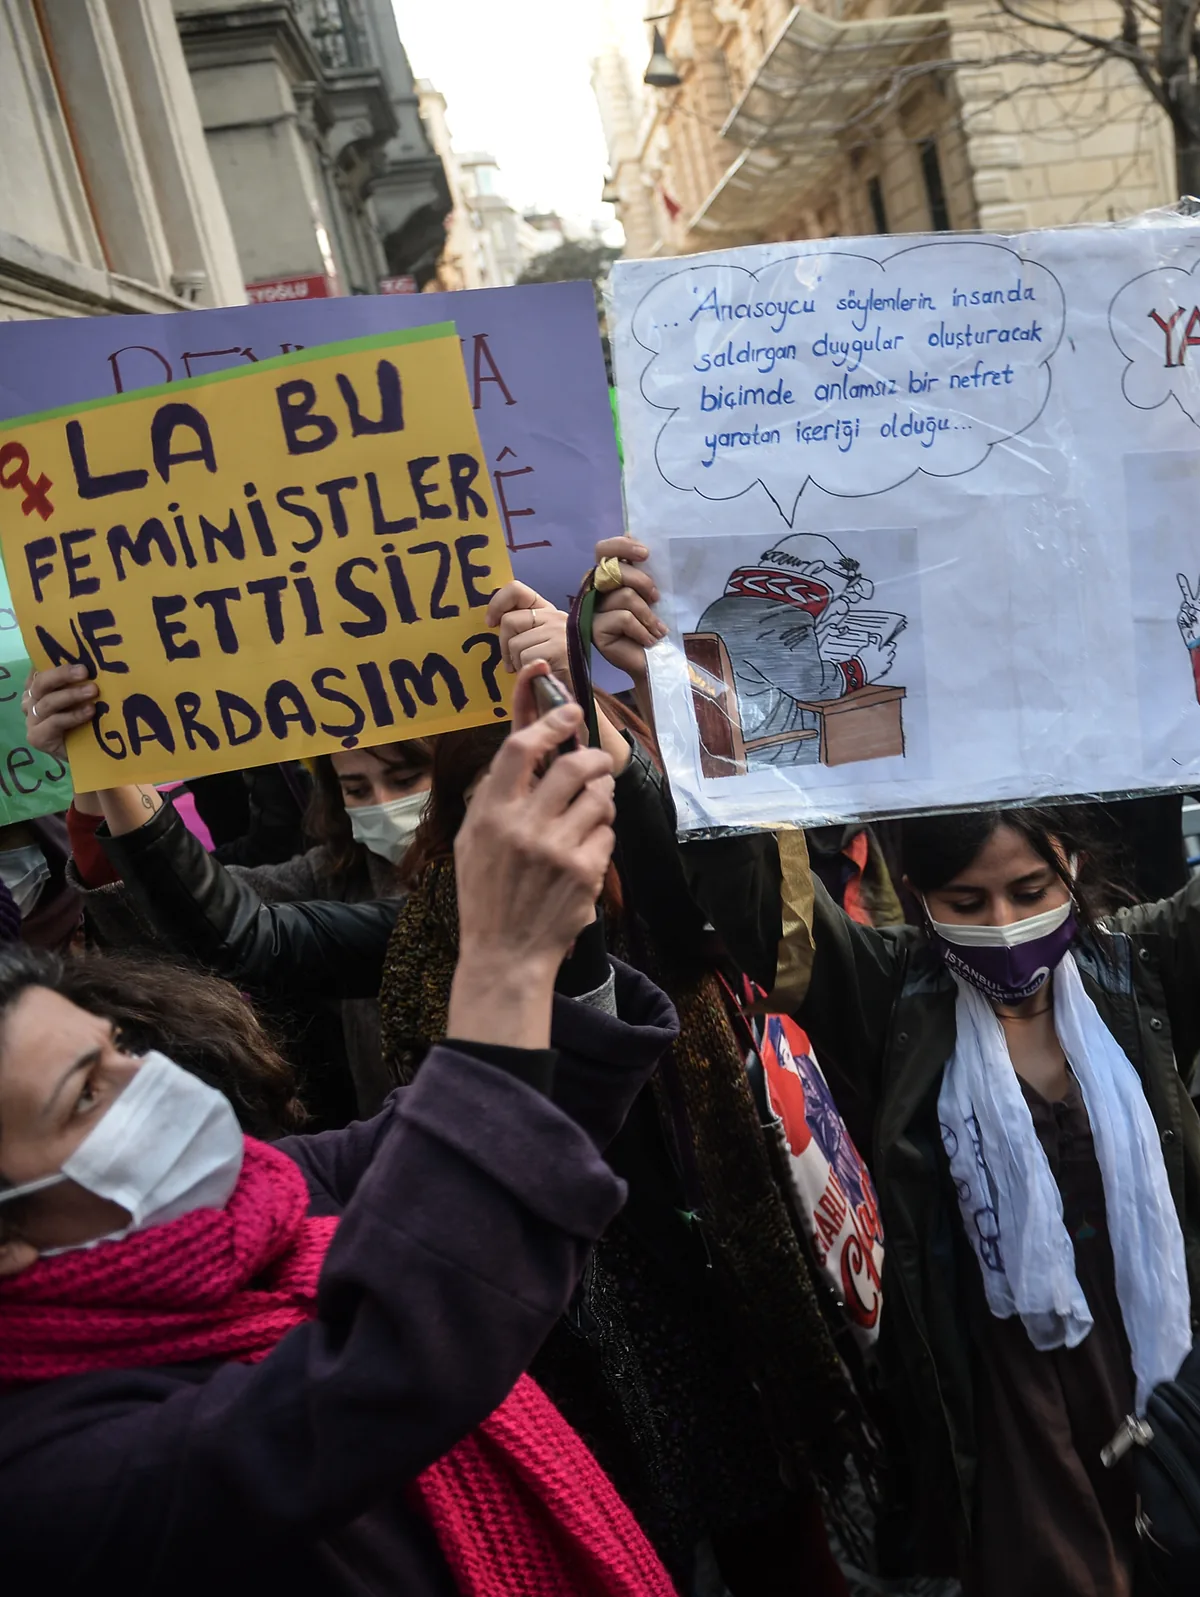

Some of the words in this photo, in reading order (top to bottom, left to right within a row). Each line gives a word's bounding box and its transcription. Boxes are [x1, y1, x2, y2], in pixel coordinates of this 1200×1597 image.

[836, 288, 936, 332] söylemlerin
[952, 279, 1036, 307] insanda
[694, 341, 797, 373] saldırgan
[812, 326, 904, 372] duygular
[927, 319, 1043, 349] oluşturacak
[700, 378, 795, 412] biçimde
[814, 373, 896, 401] anlamsız
[909, 370, 939, 393] bir
[949, 360, 1014, 389] nefret
[66, 402, 217, 499] LA
[276, 359, 404, 455] BU
[701, 423, 781, 468] yaratan
[796, 417, 860, 452] içeriği
[24, 452, 488, 602] FEMİNİSTLER
[36, 609, 130, 680] NE
[92, 632, 507, 761] GARDAŞIM?
